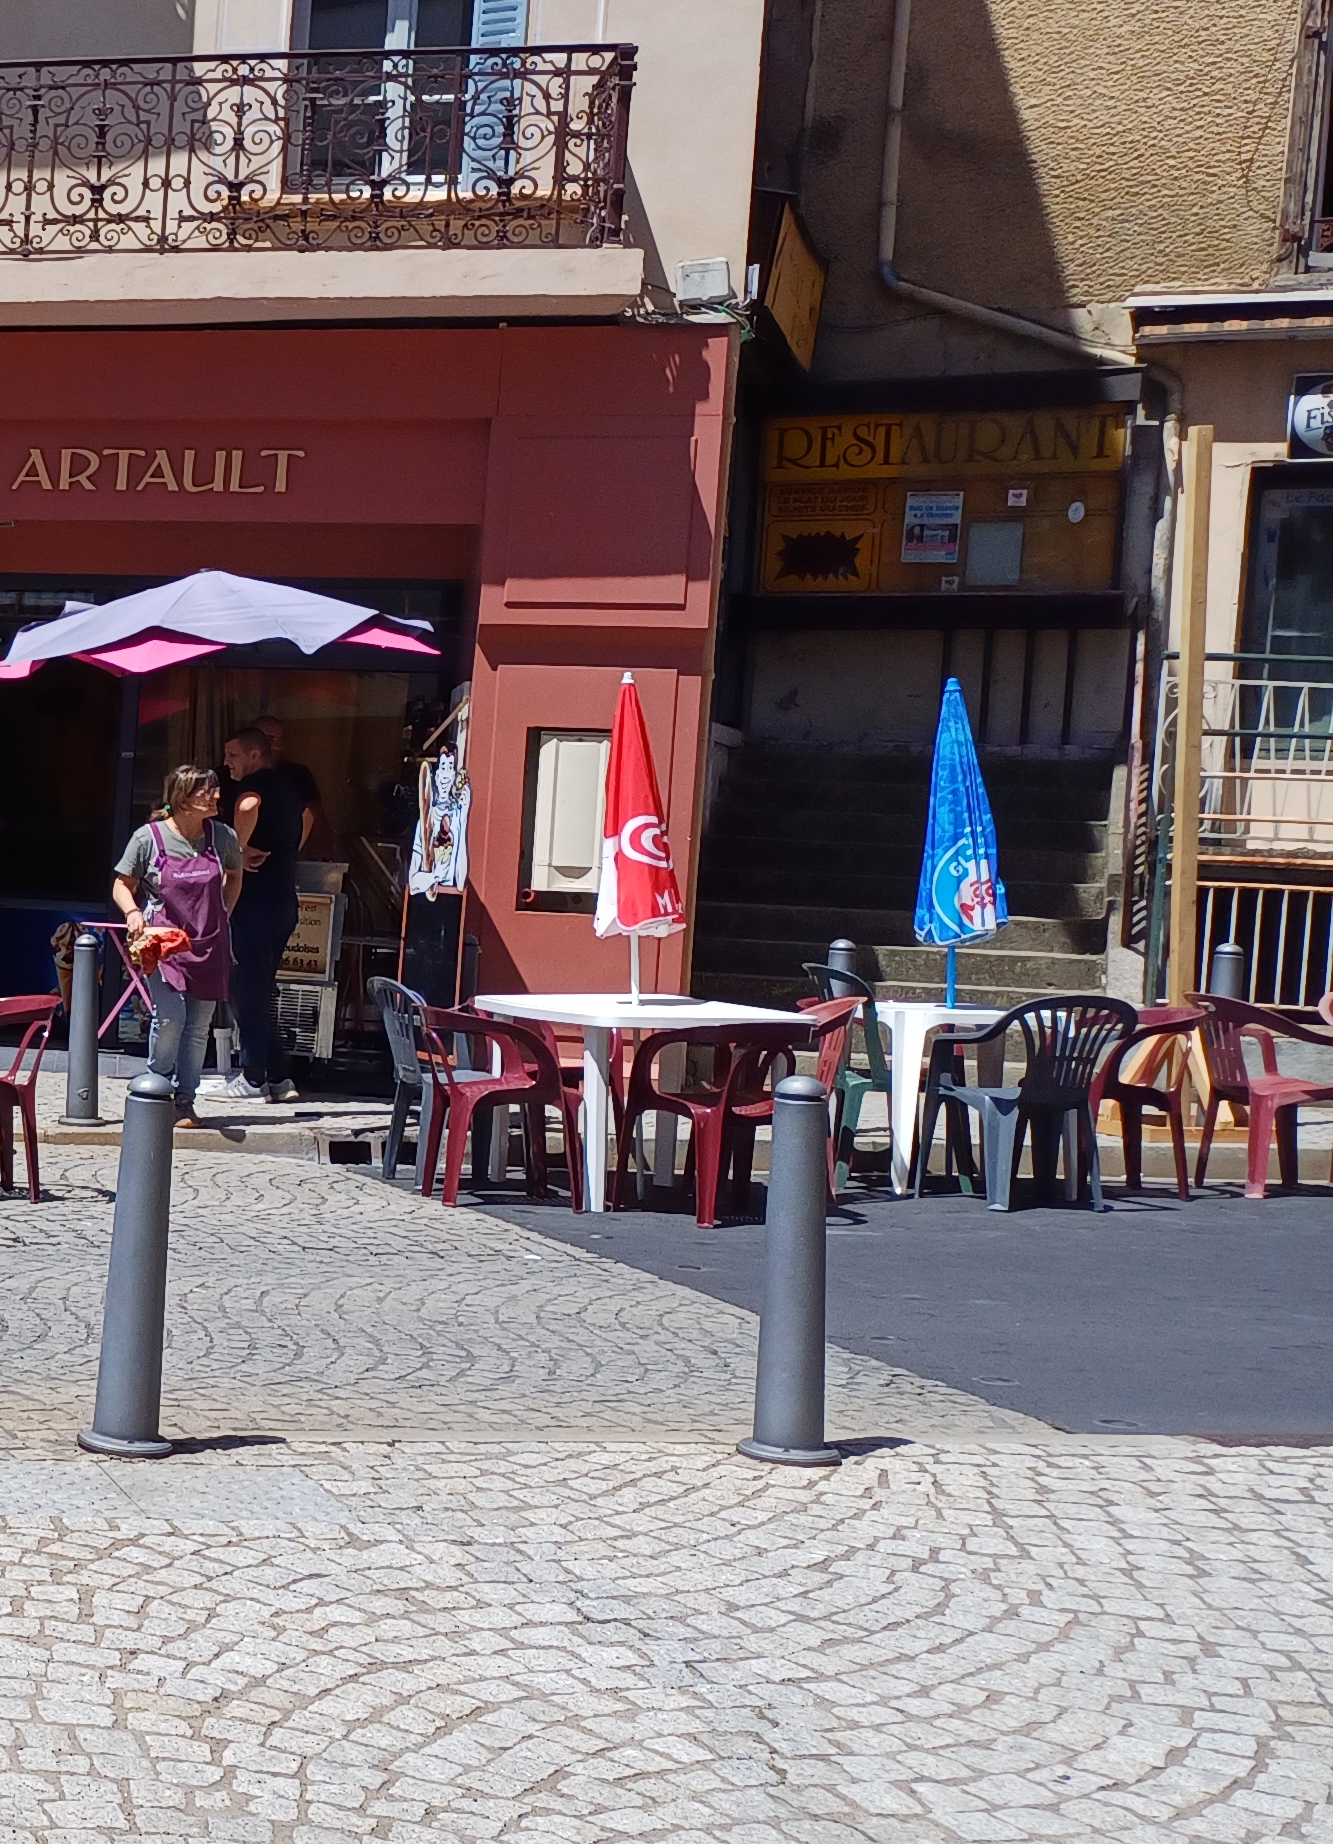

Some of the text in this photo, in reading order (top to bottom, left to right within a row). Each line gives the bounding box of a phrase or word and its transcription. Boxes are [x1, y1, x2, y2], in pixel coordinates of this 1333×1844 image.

[774, 413, 1124, 470] RESTAURANT
[11, 448, 306, 493] ARTAULT
[299, 916, 322, 926] sition
